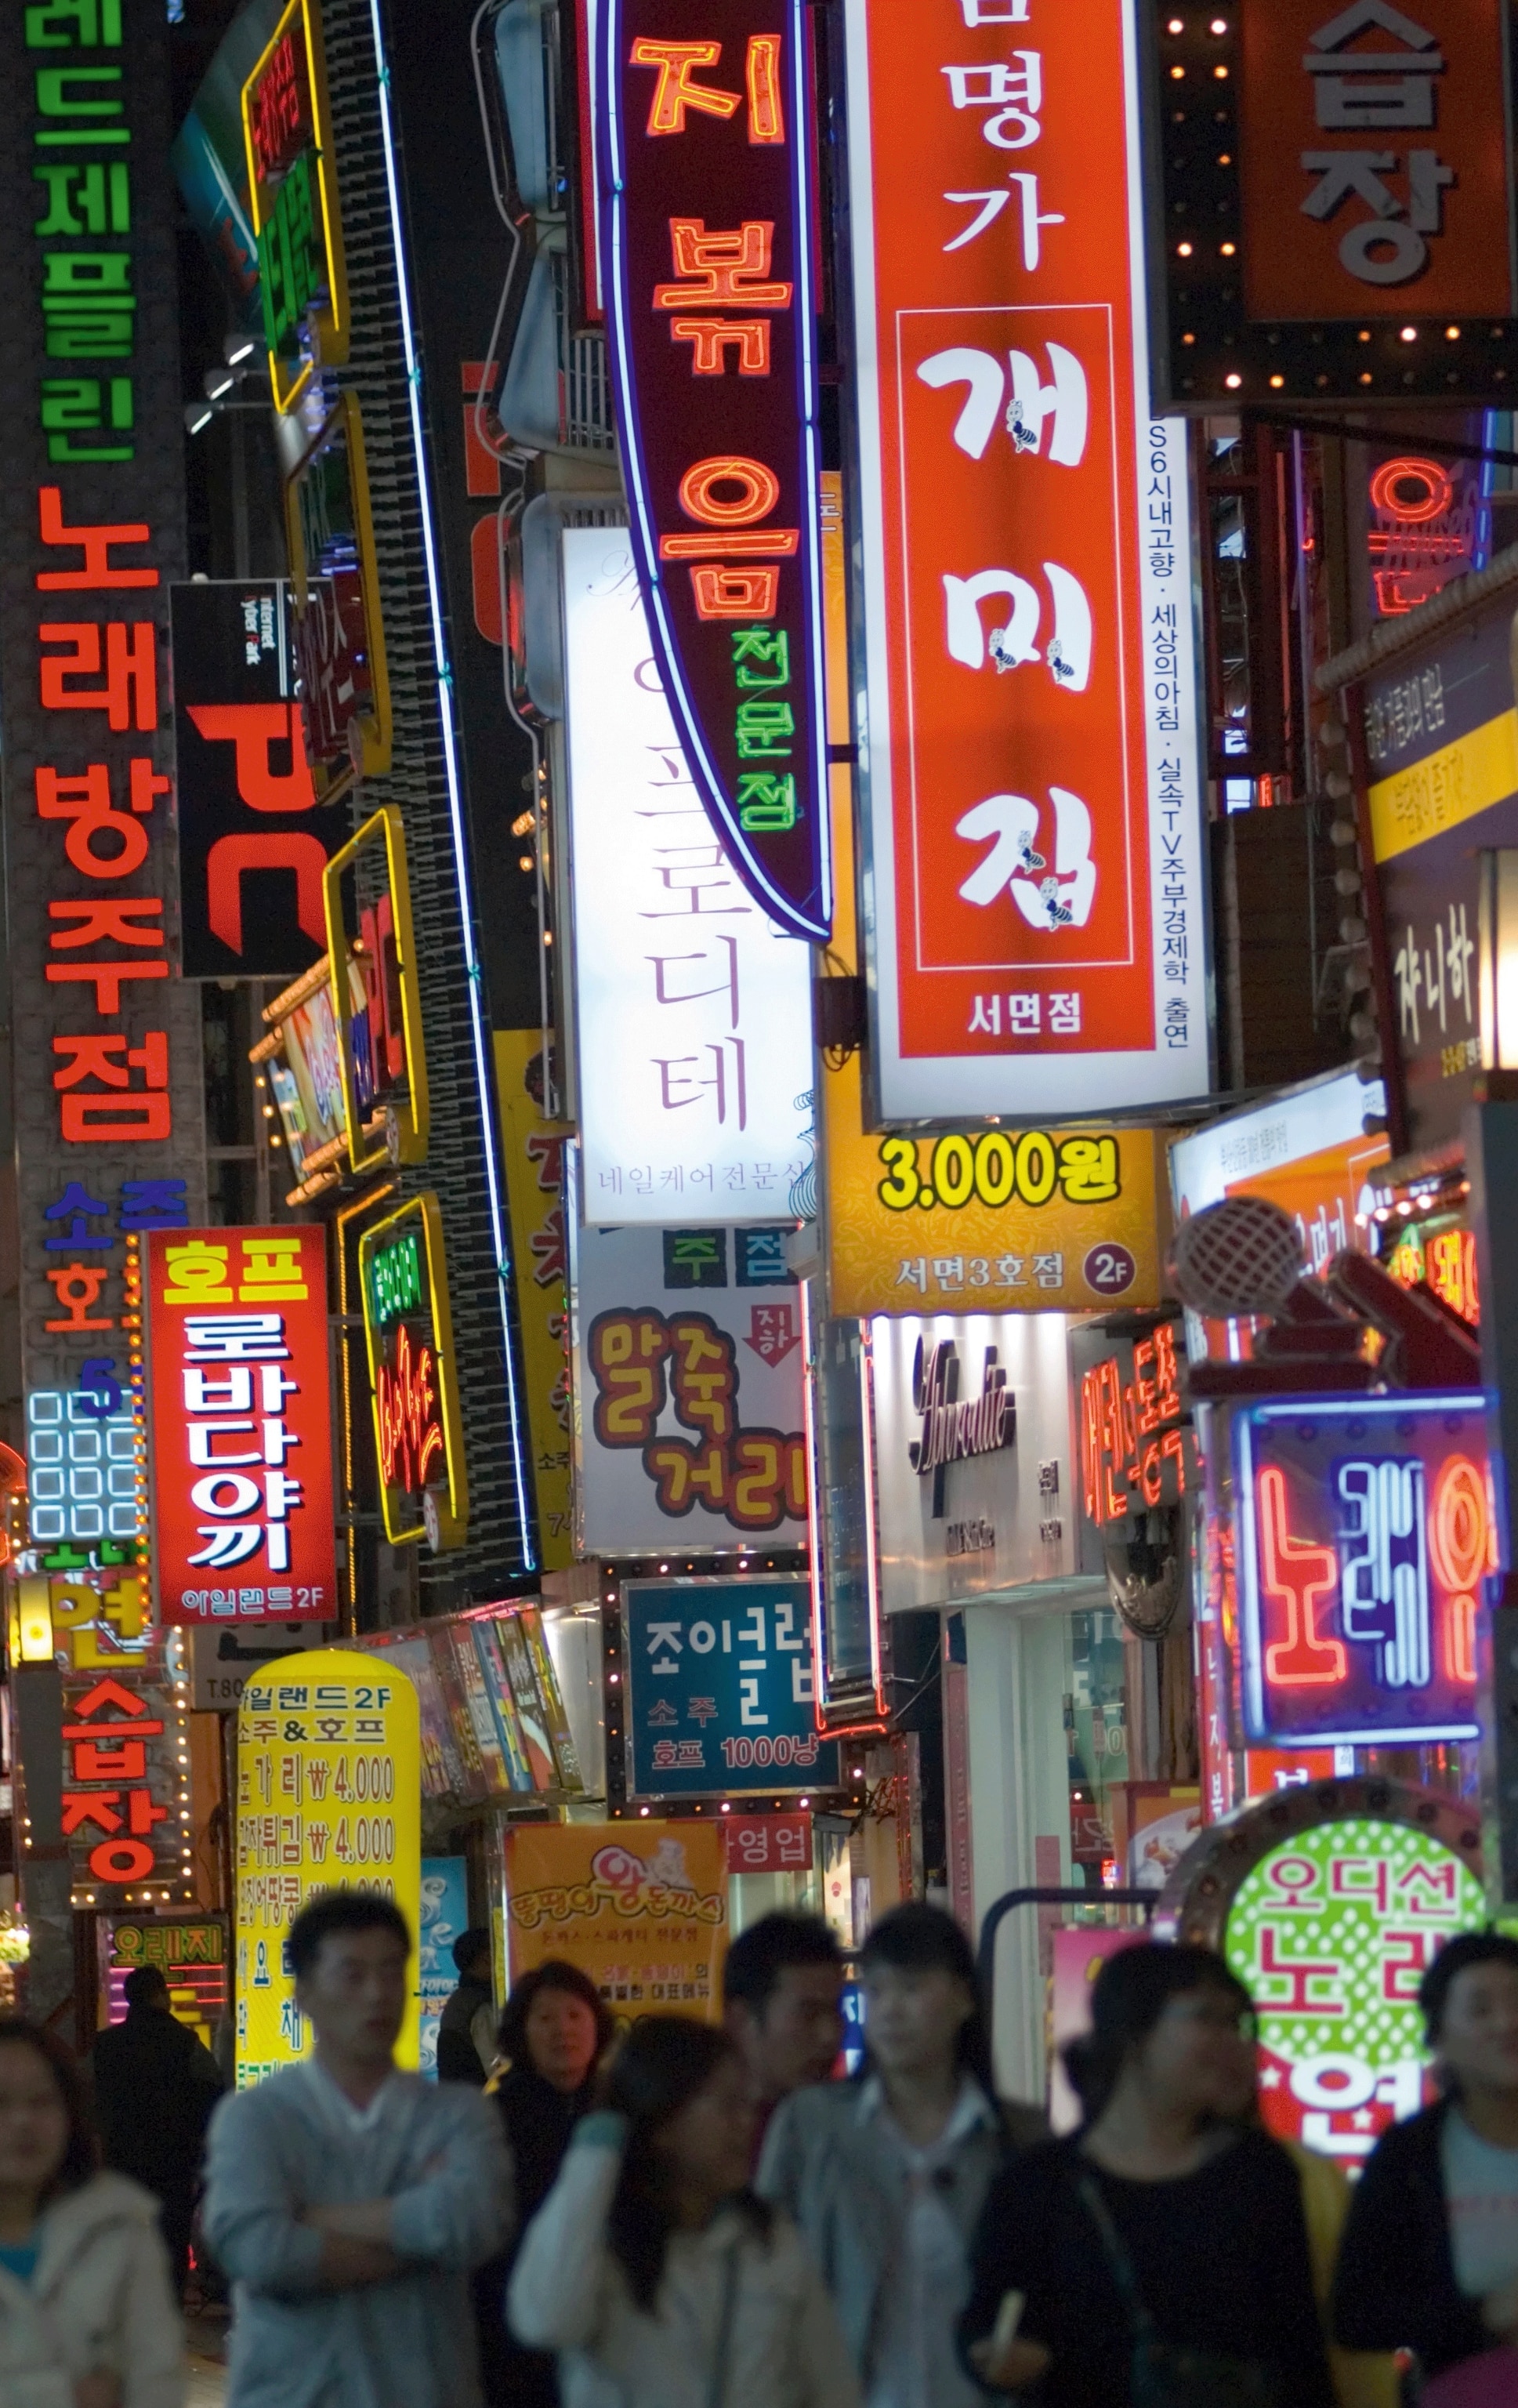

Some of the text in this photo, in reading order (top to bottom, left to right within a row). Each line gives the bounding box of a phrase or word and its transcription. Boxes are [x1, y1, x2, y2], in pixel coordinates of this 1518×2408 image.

[939, 0, 1066, 272] 명가
[917, 342, 1097, 931] 개미집
[730, 627, 796, 833] 전문점
[37, 486, 170, 1142] 노래방주점
[969, 993, 1082, 1036] 서면점
[1164, 997, 1190, 1049] 출연
[879, 1130, 1121, 1212] 3.000원
[164, 1241, 308, 1304] 호프
[895, 1254, 1128, 1295] 서면3호점 2F
[756, 1308, 790, 1355] 지하
[181, 1315, 303, 1571] 로바다야끼
[283, 1720, 308, 1742] &
[314, 1717, 384, 1743] 호프
[647, 1698, 719, 1728] 소주
[652, 1733, 819, 1770] 호프 1000냥
[1264, 1856, 1455, 1914] 오디션
